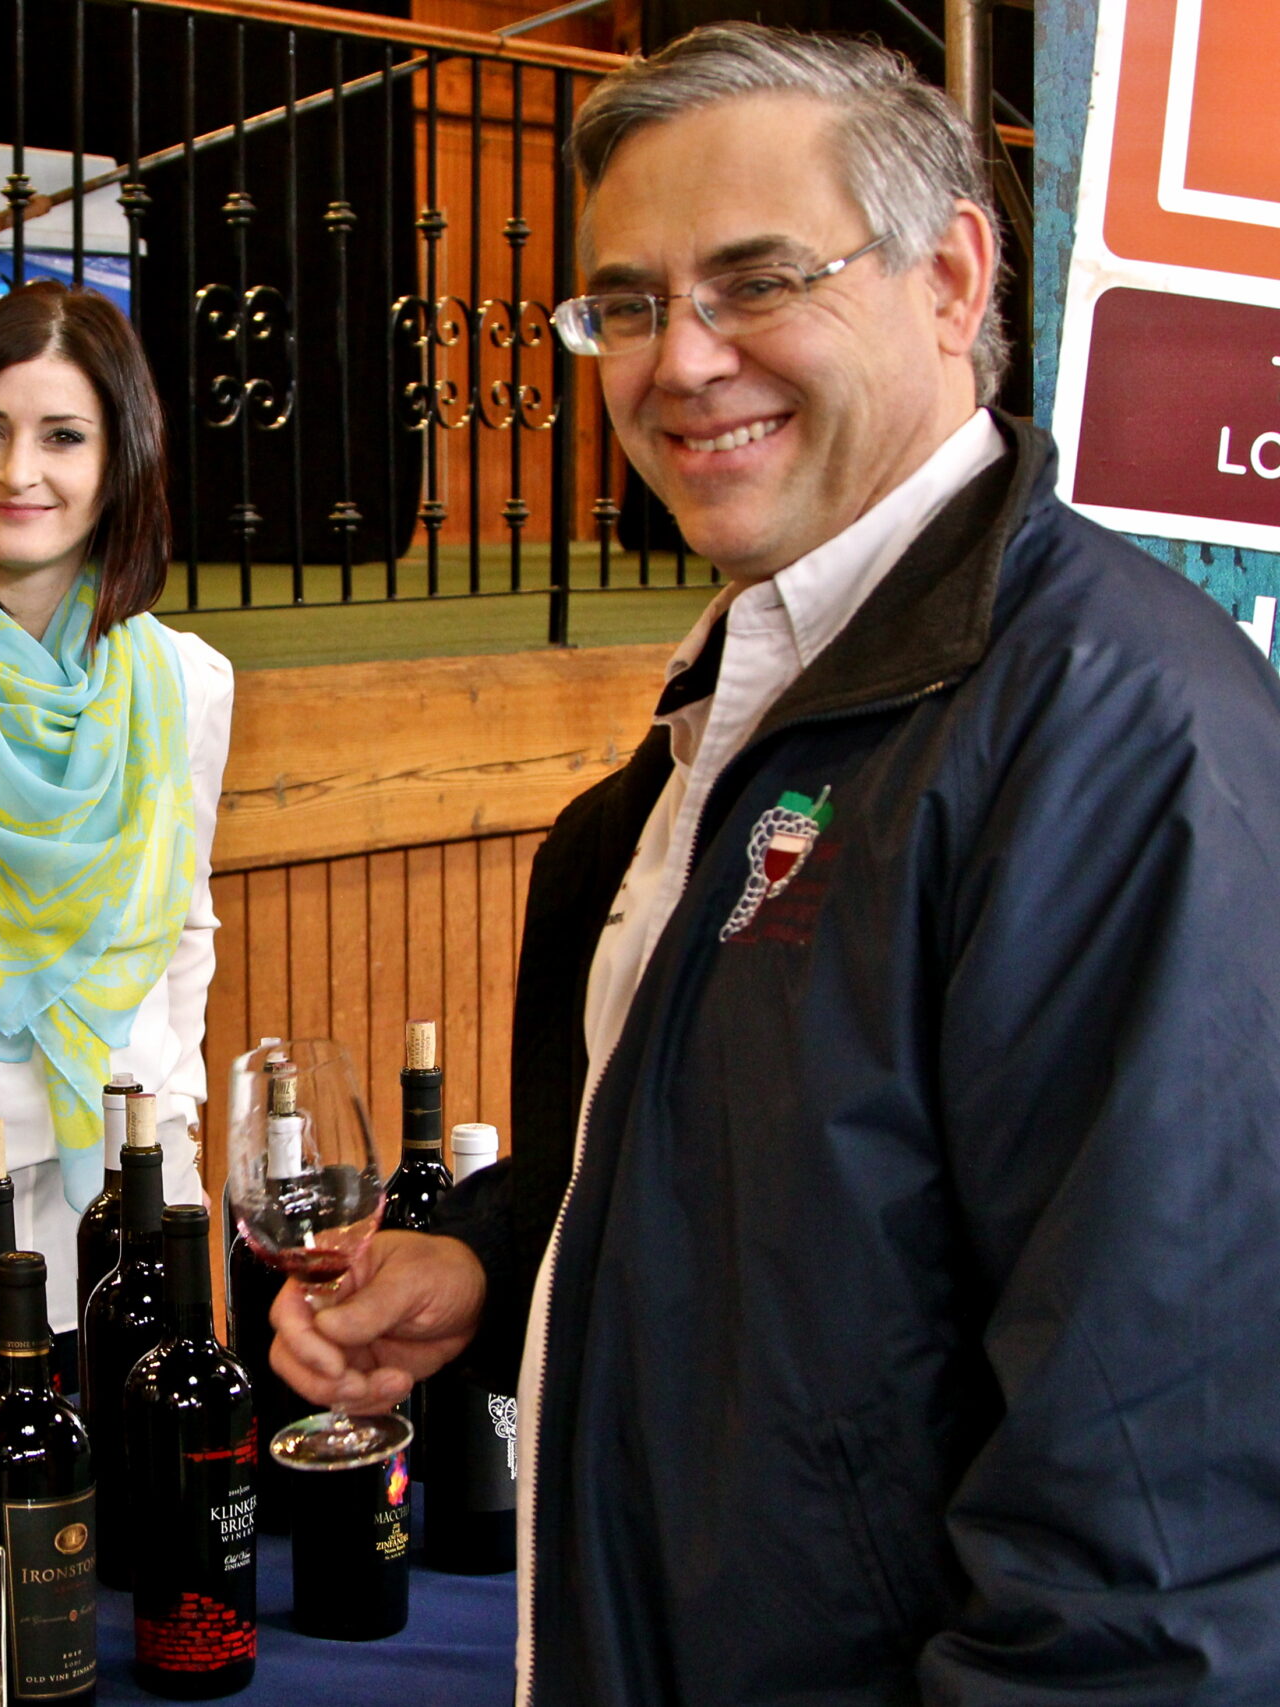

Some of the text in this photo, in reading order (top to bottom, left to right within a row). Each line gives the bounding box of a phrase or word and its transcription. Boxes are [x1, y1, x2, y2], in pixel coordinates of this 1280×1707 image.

[1218, 425, 1280, 479] LO
[210, 1495, 257, 1521] KLINKER
[374, 1504, 410, 1525] MACCHI
[220, 1511, 255, 1535] BRICK
[221, 1526, 254, 1543] WINERY
[21, 1556, 97, 1585] IRONSTON
[25, 1676, 46, 1684] OLD
[49, 1673, 70, 1683] VINE
